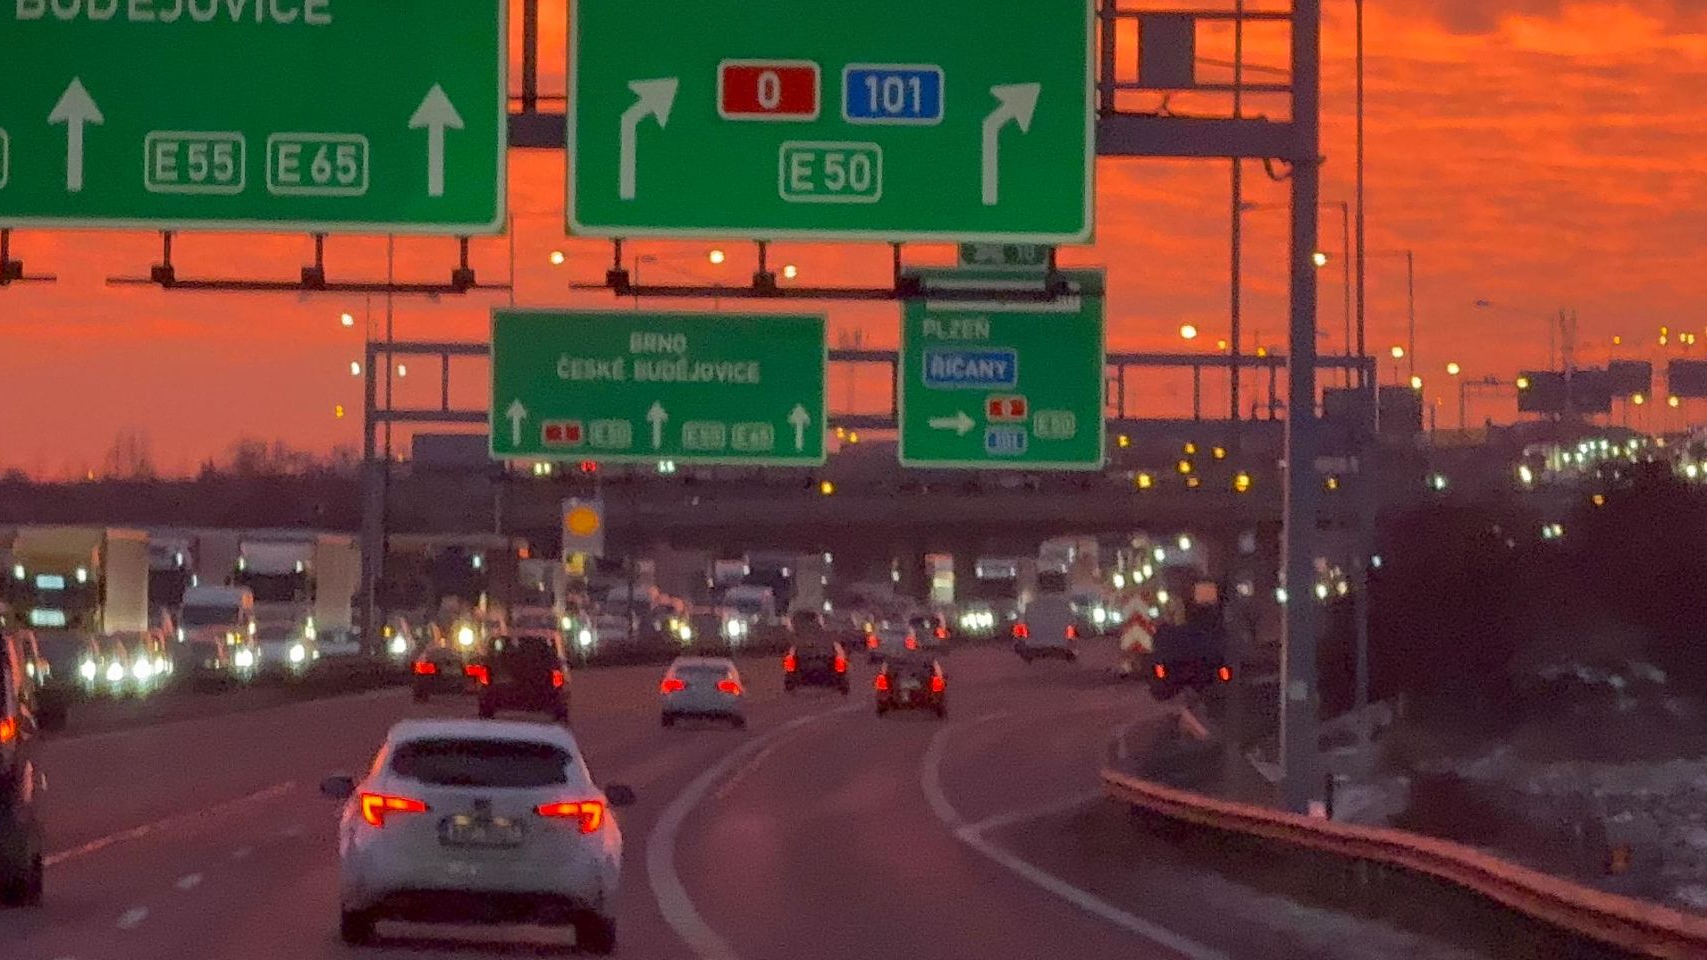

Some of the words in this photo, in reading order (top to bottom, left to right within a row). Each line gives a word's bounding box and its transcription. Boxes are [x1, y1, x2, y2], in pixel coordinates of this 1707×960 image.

[757, 72, 781, 108] 0
[864, 75, 922, 113] 101
[155, 142, 177, 182] E
[187, 143, 235, 184] 55
[277, 146, 300, 184] E
[309, 144, 358, 185] 65
[789, 153, 814, 189] E
[823, 153, 871, 191] 50
[629, 331, 687, 355] BRNO
